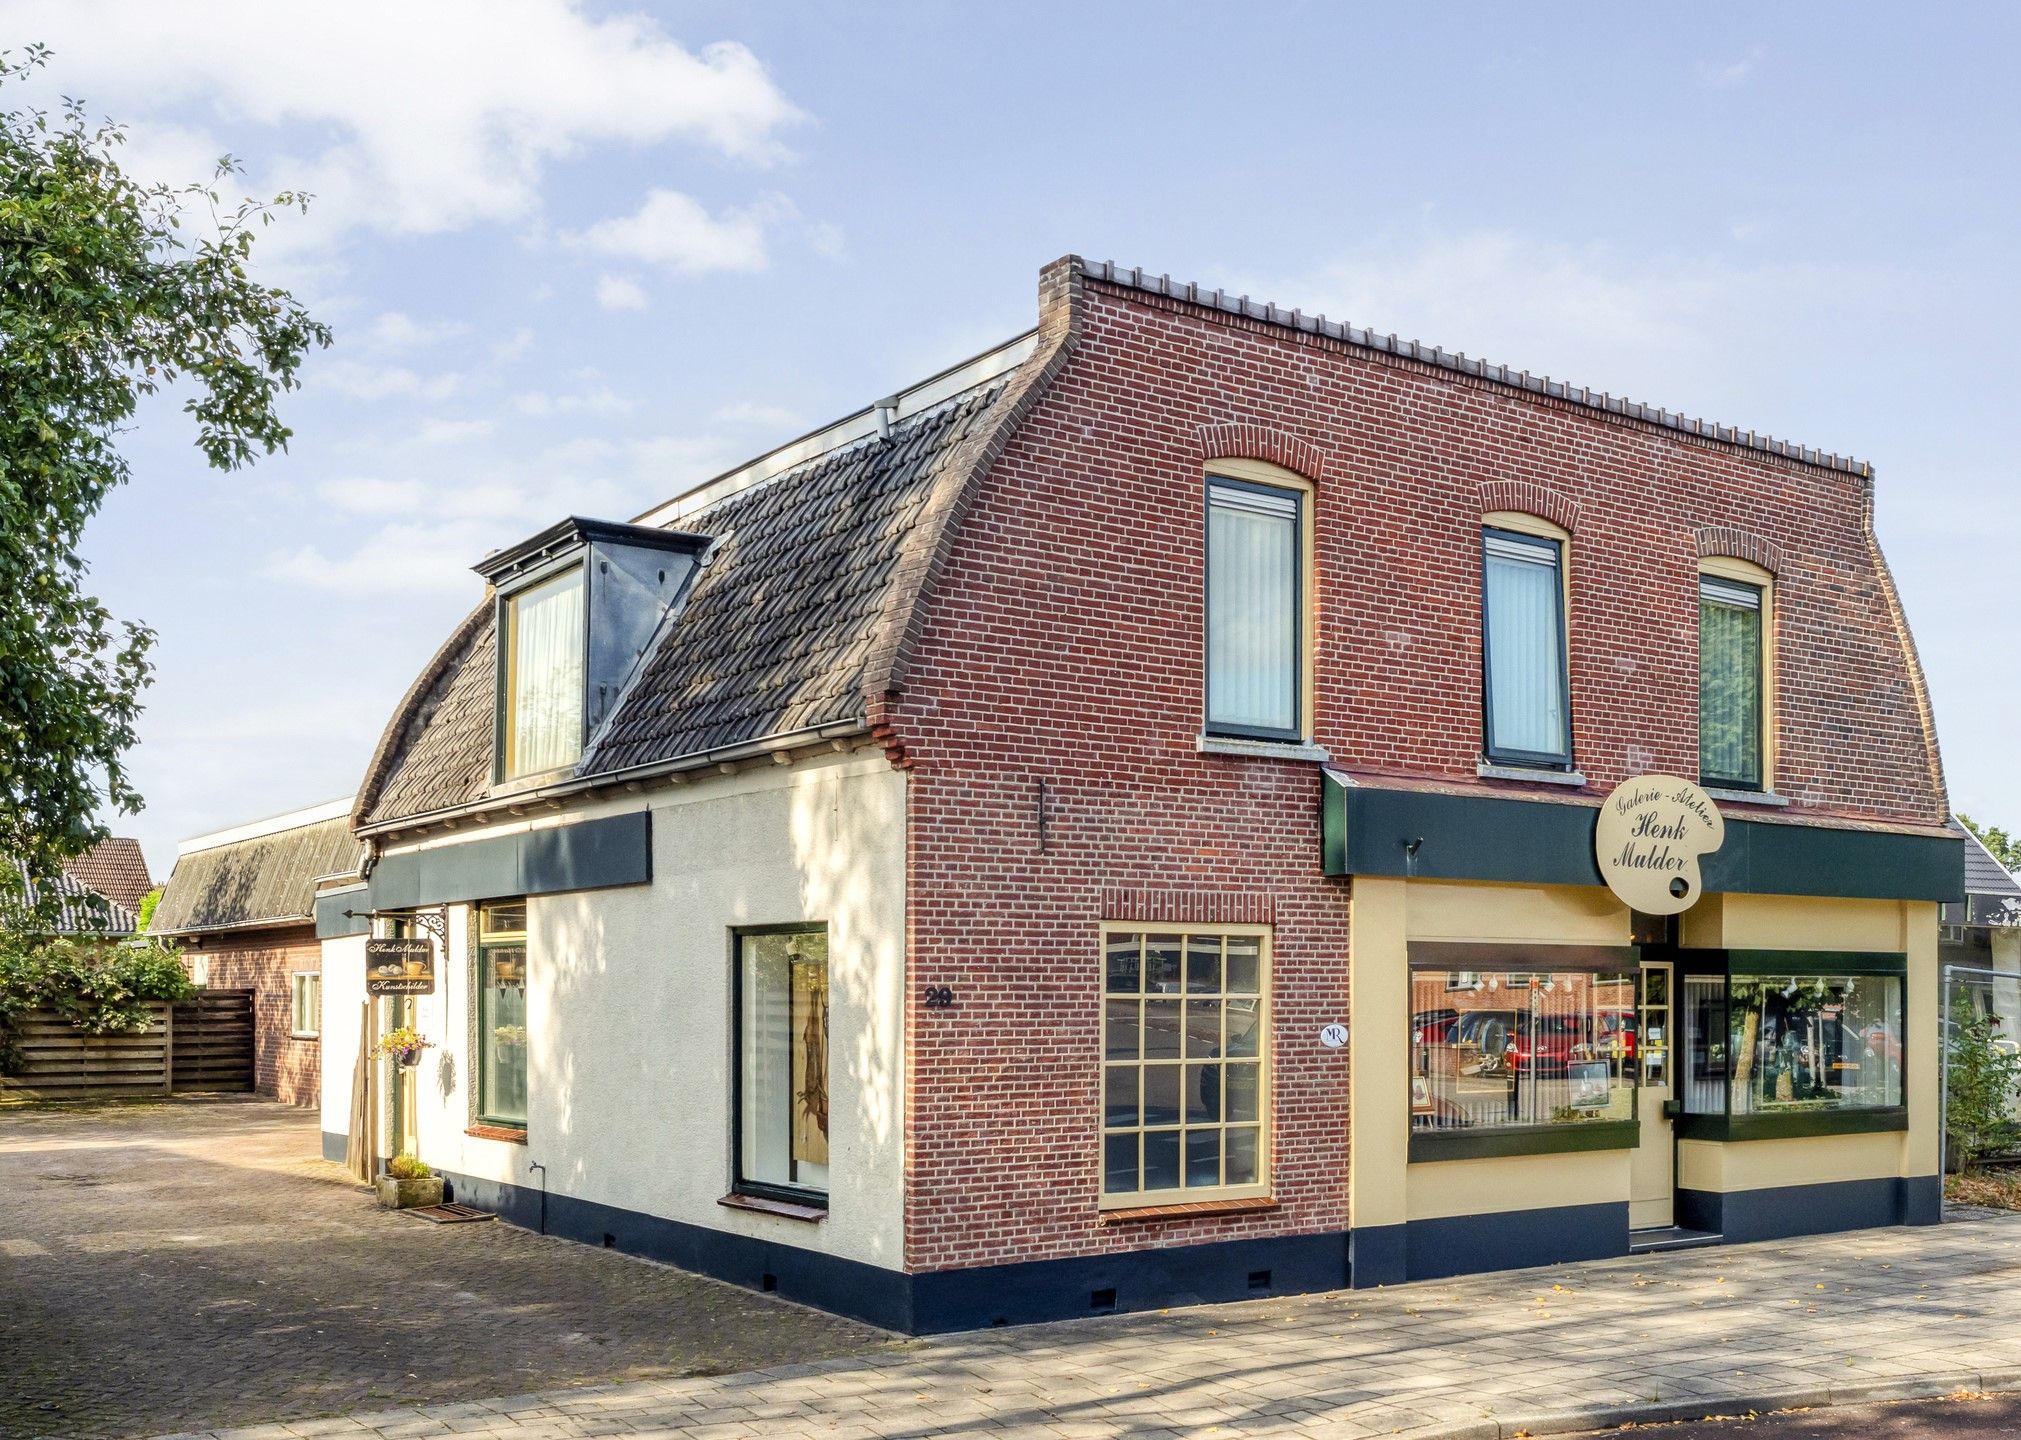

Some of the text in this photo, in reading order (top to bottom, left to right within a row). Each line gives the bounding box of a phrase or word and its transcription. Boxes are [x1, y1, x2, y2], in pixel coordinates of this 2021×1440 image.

[1616, 788, 1662, 815] Galerie
[1672, 788, 1715, 830] Atelier
[1632, 811, 1689, 840] Henk
[1613, 842, 1688, 871] Mulder
[369, 943, 429, 953] Henk Mulder
[372, 981, 428, 990] Kunstschilder
